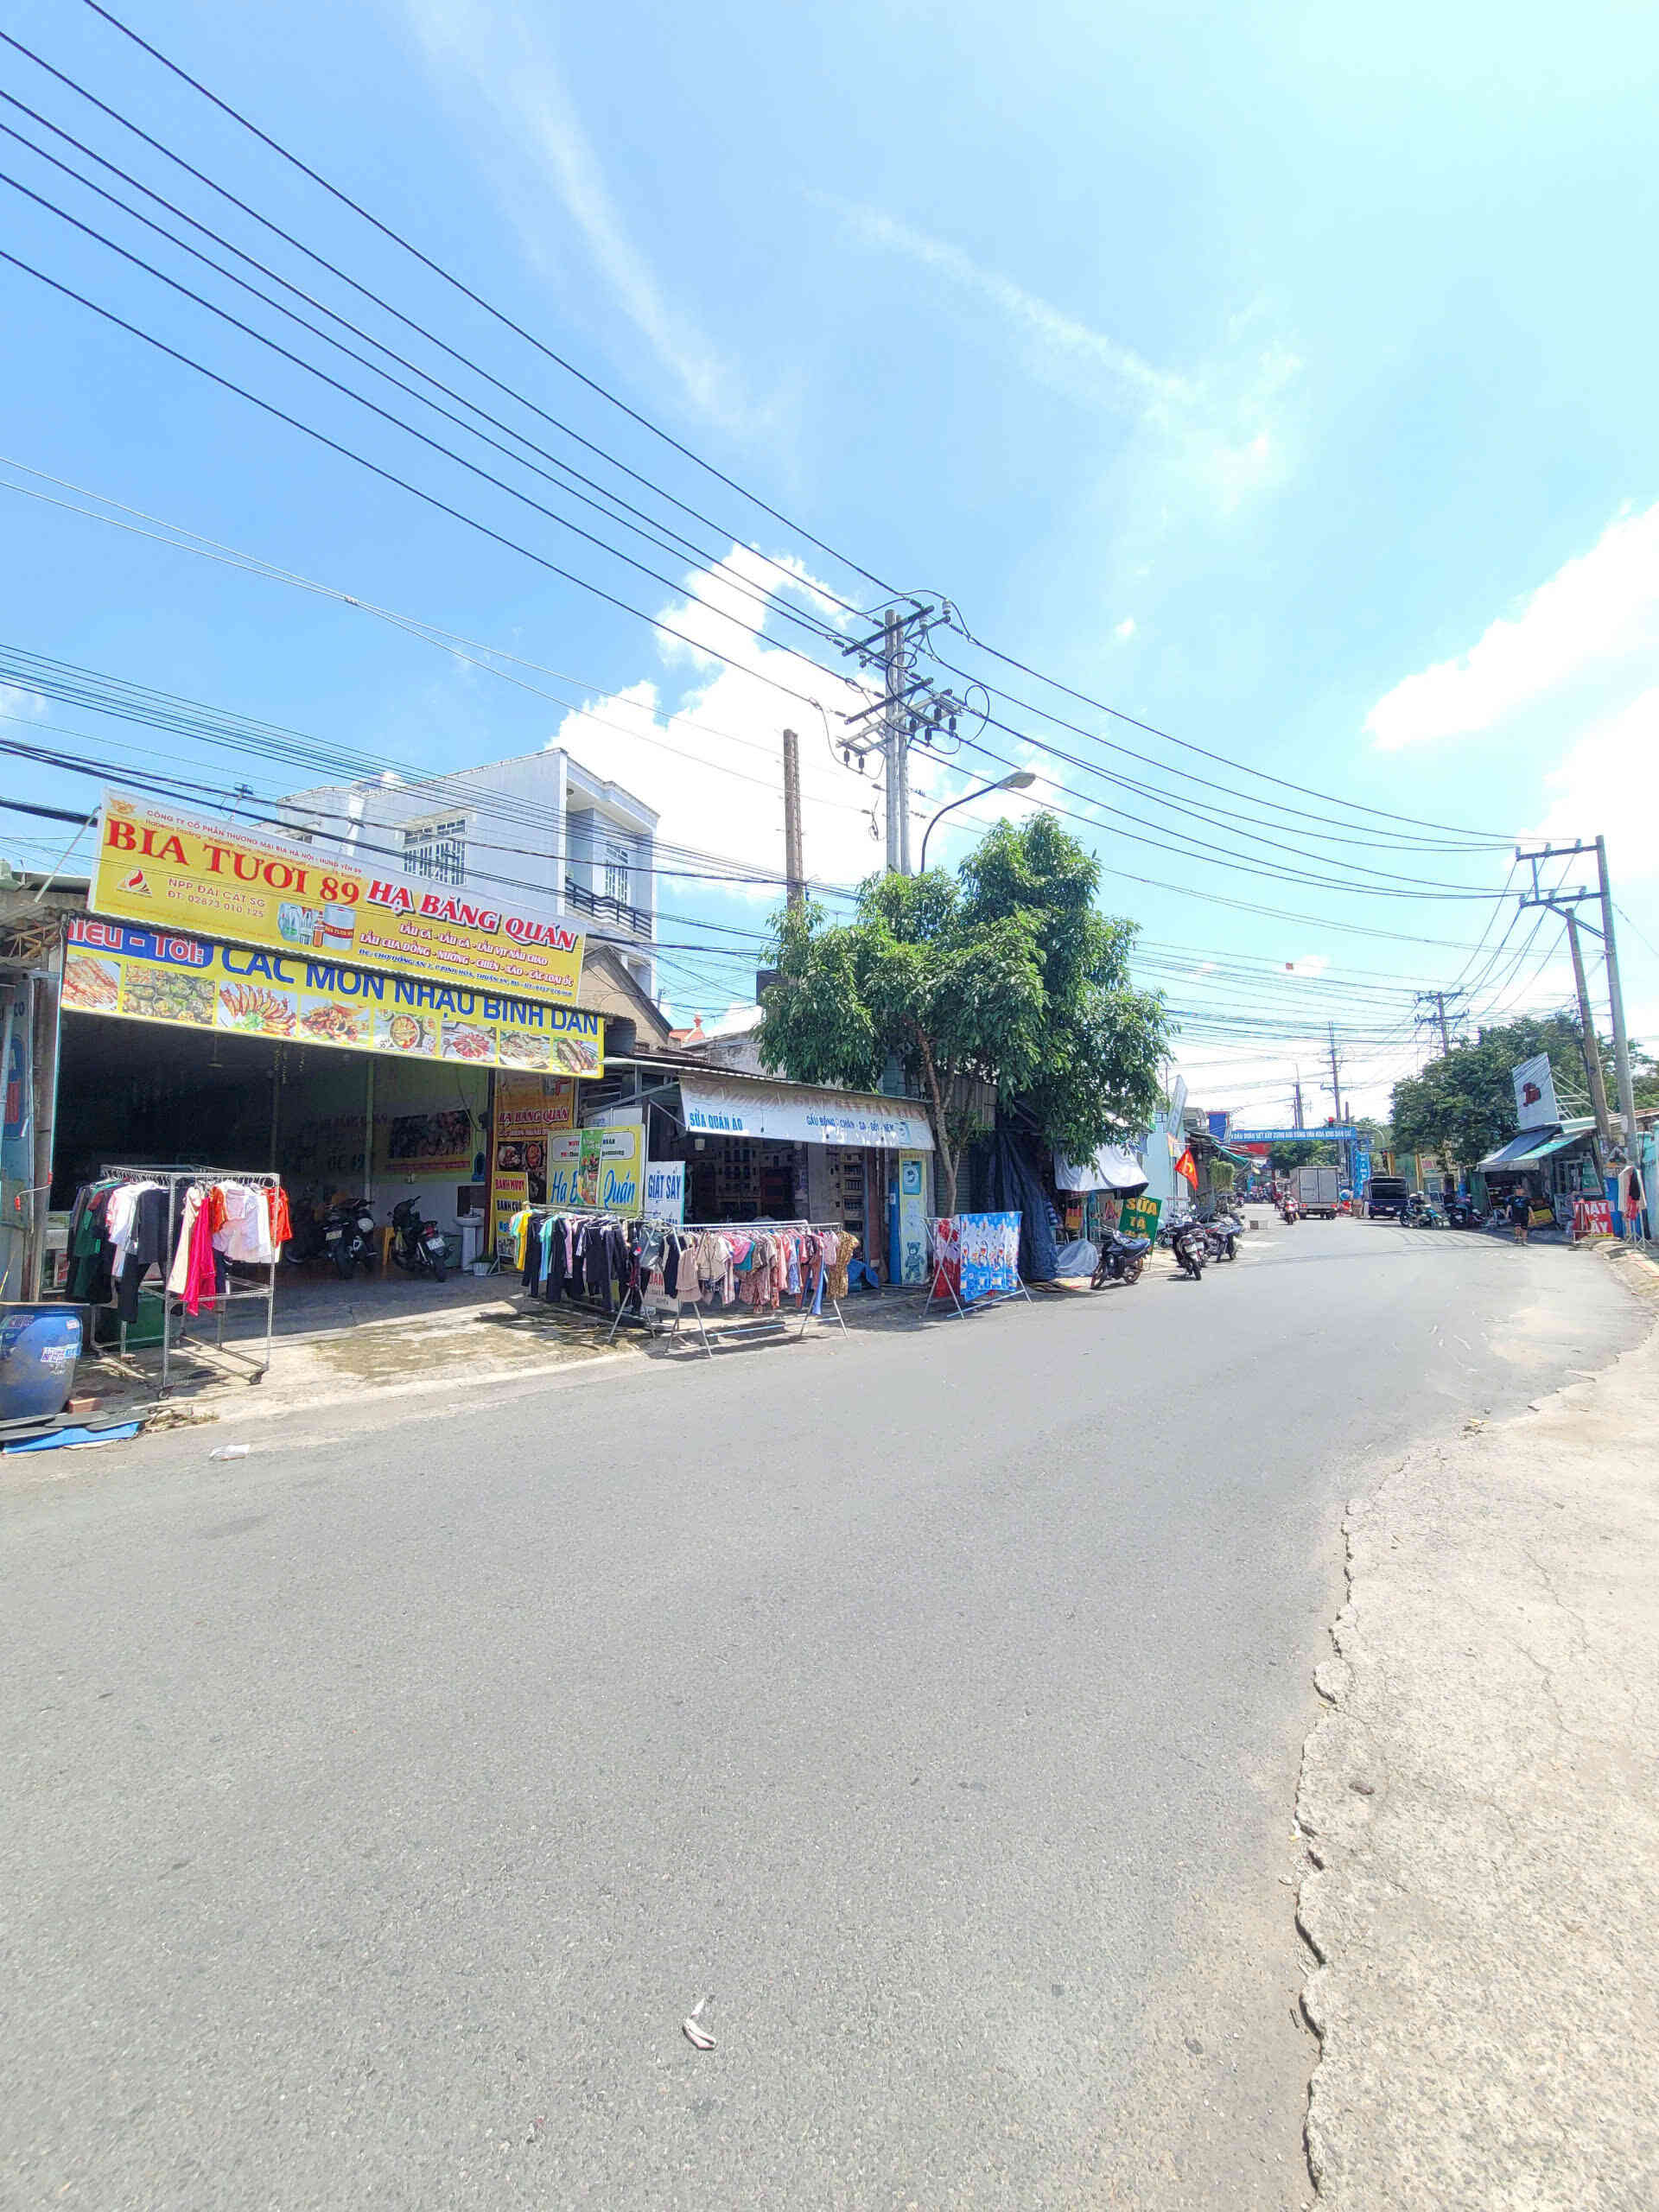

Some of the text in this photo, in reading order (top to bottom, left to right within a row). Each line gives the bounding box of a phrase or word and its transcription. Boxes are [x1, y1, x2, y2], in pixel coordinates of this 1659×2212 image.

[146, 809, 174, 822] CÔNG
[103, 818, 190, 866] BIA
[201, 843, 309, 895] TƯƠI
[319, 876, 360, 906] 89
[168, 878, 194, 890] NPP
[249, 897, 265, 907] SG
[366, 879, 415, 916] HẠ
[505, 916, 578, 952] QUÁN
[603, 1168, 635, 1211] Quán
